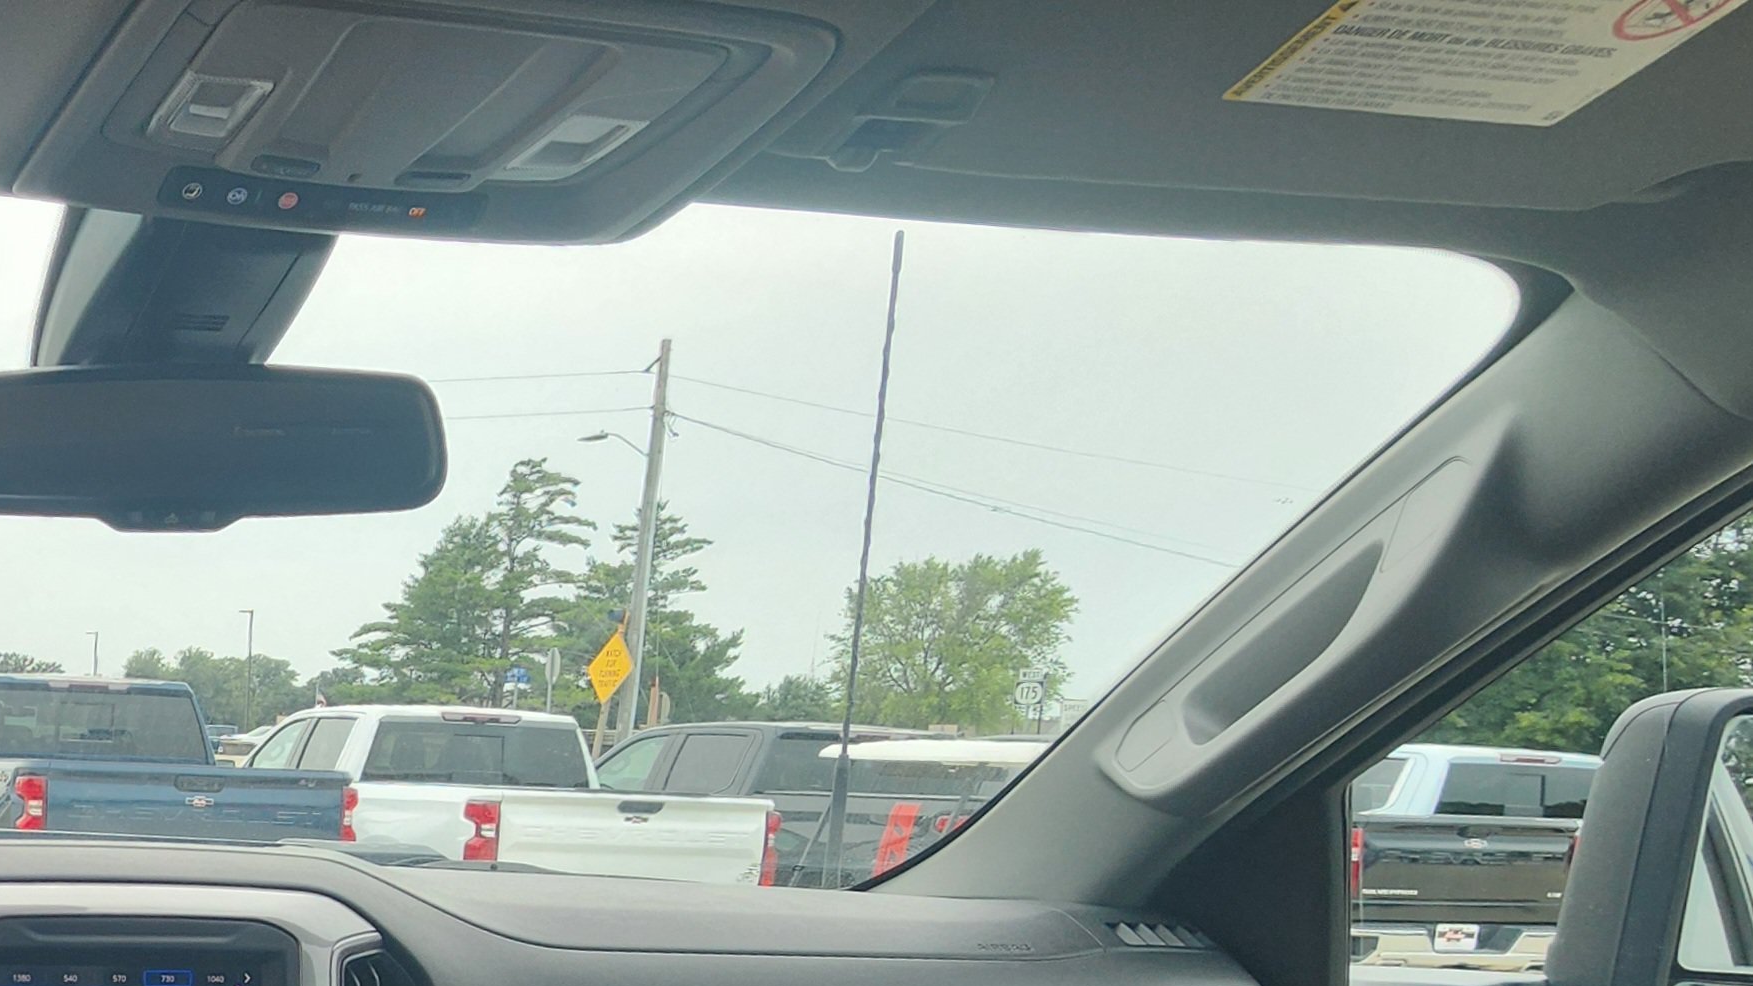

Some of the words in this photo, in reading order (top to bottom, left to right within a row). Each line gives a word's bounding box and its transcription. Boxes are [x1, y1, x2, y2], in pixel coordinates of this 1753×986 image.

[1333, 24, 1390, 38] DANGER
[1407, 31, 1452, 42] MORT
[408, 207, 427, 217] OFF
[1020, 686, 1039, 700] 175
[63, 974, 78, 983] 540
[112, 974, 127, 983] 570
[161, 975, 176, 983] 730
[207, 975, 225, 984] 1040
